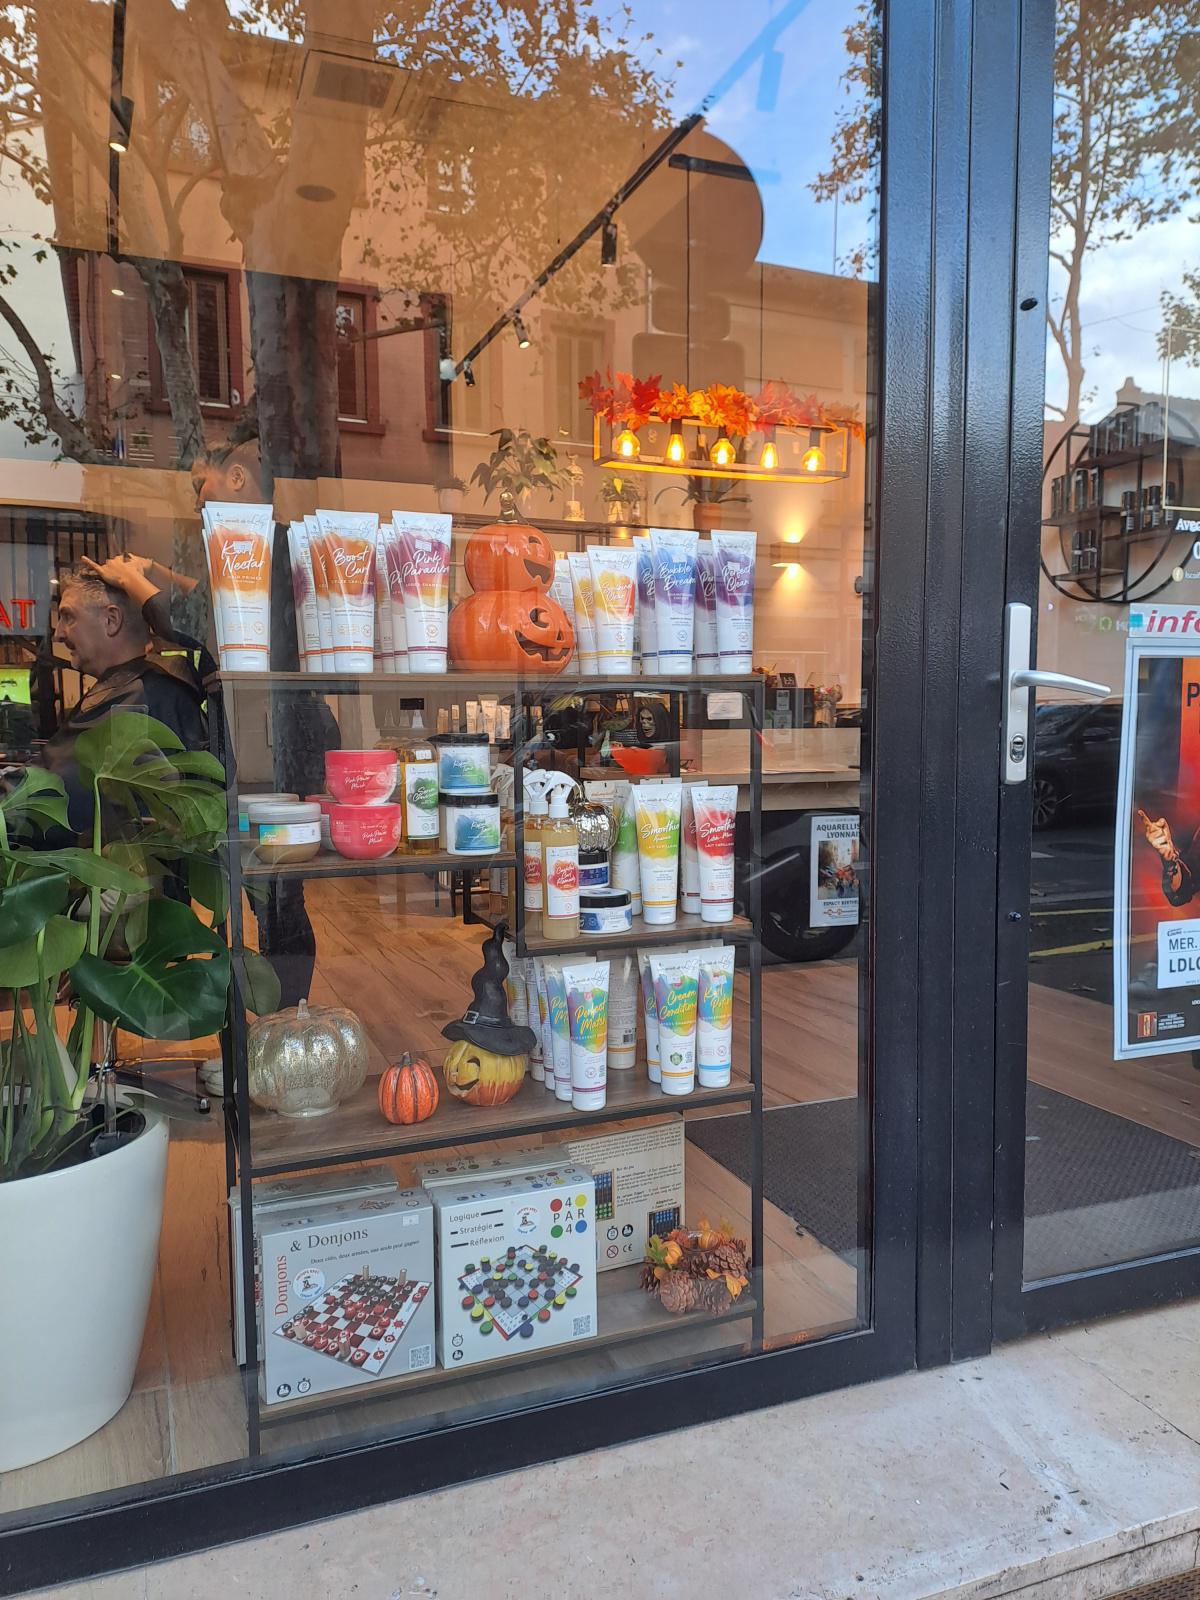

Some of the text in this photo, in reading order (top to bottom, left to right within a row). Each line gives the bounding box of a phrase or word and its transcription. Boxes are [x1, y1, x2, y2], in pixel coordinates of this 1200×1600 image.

[333, 546, 369, 566] Boost
[413, 550, 442, 568] Pink
[222, 554, 265, 576] Nectar
[659, 560, 692, 578] Bubble
[664, 574, 696, 591] Dream
[1169, 938, 1198, 951] MER.
[565, 1197, 572, 1208] 4
[450, 1212, 480, 1222] Logique
[460, 1224, 492, 1235] Stratégie
[566, 1224, 572, 1234] 4
[290, 1228, 368, 1252] & Donjons
[470, 1236, 504, 1247] Réflexion
[275, 1256, 292, 1316] Donjons
